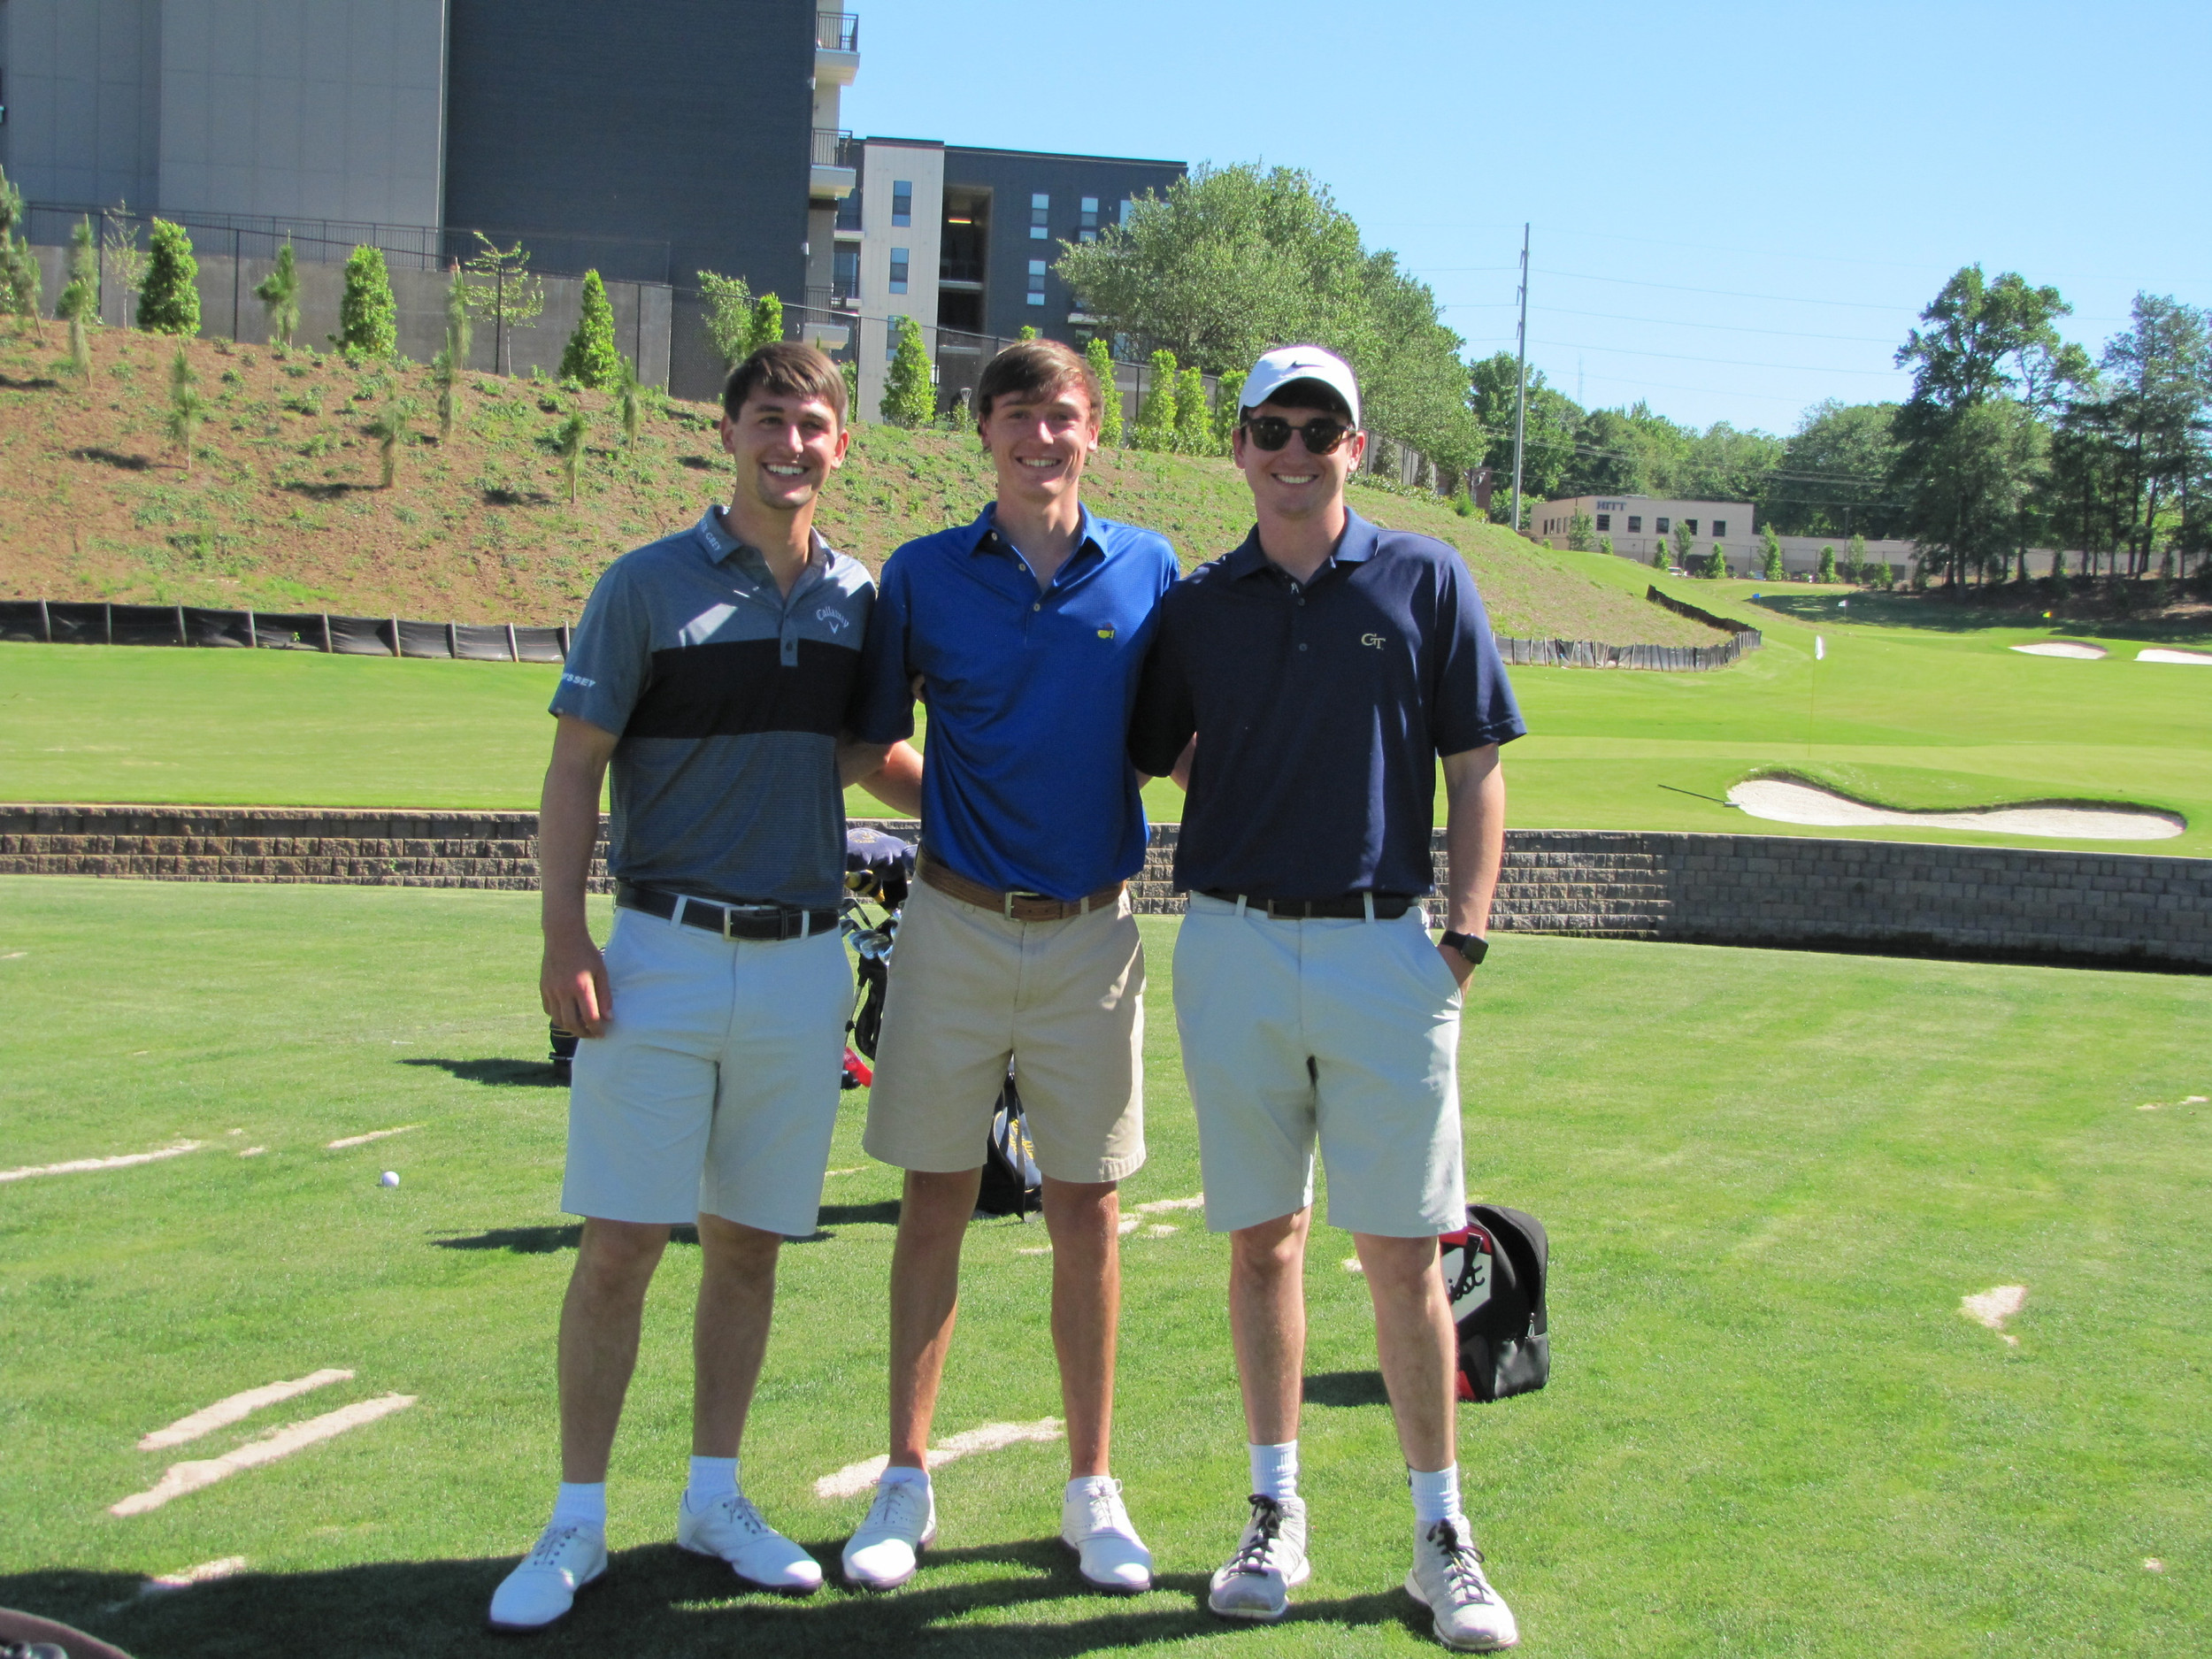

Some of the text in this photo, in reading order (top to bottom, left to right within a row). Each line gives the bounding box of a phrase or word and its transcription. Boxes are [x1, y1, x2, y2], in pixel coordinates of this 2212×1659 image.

[705, 532, 722, 551] GREY
[816, 605, 849, 629] Callaway
[1361, 633, 1386, 649] GT
[562, 672, 596, 687] YSSEY
